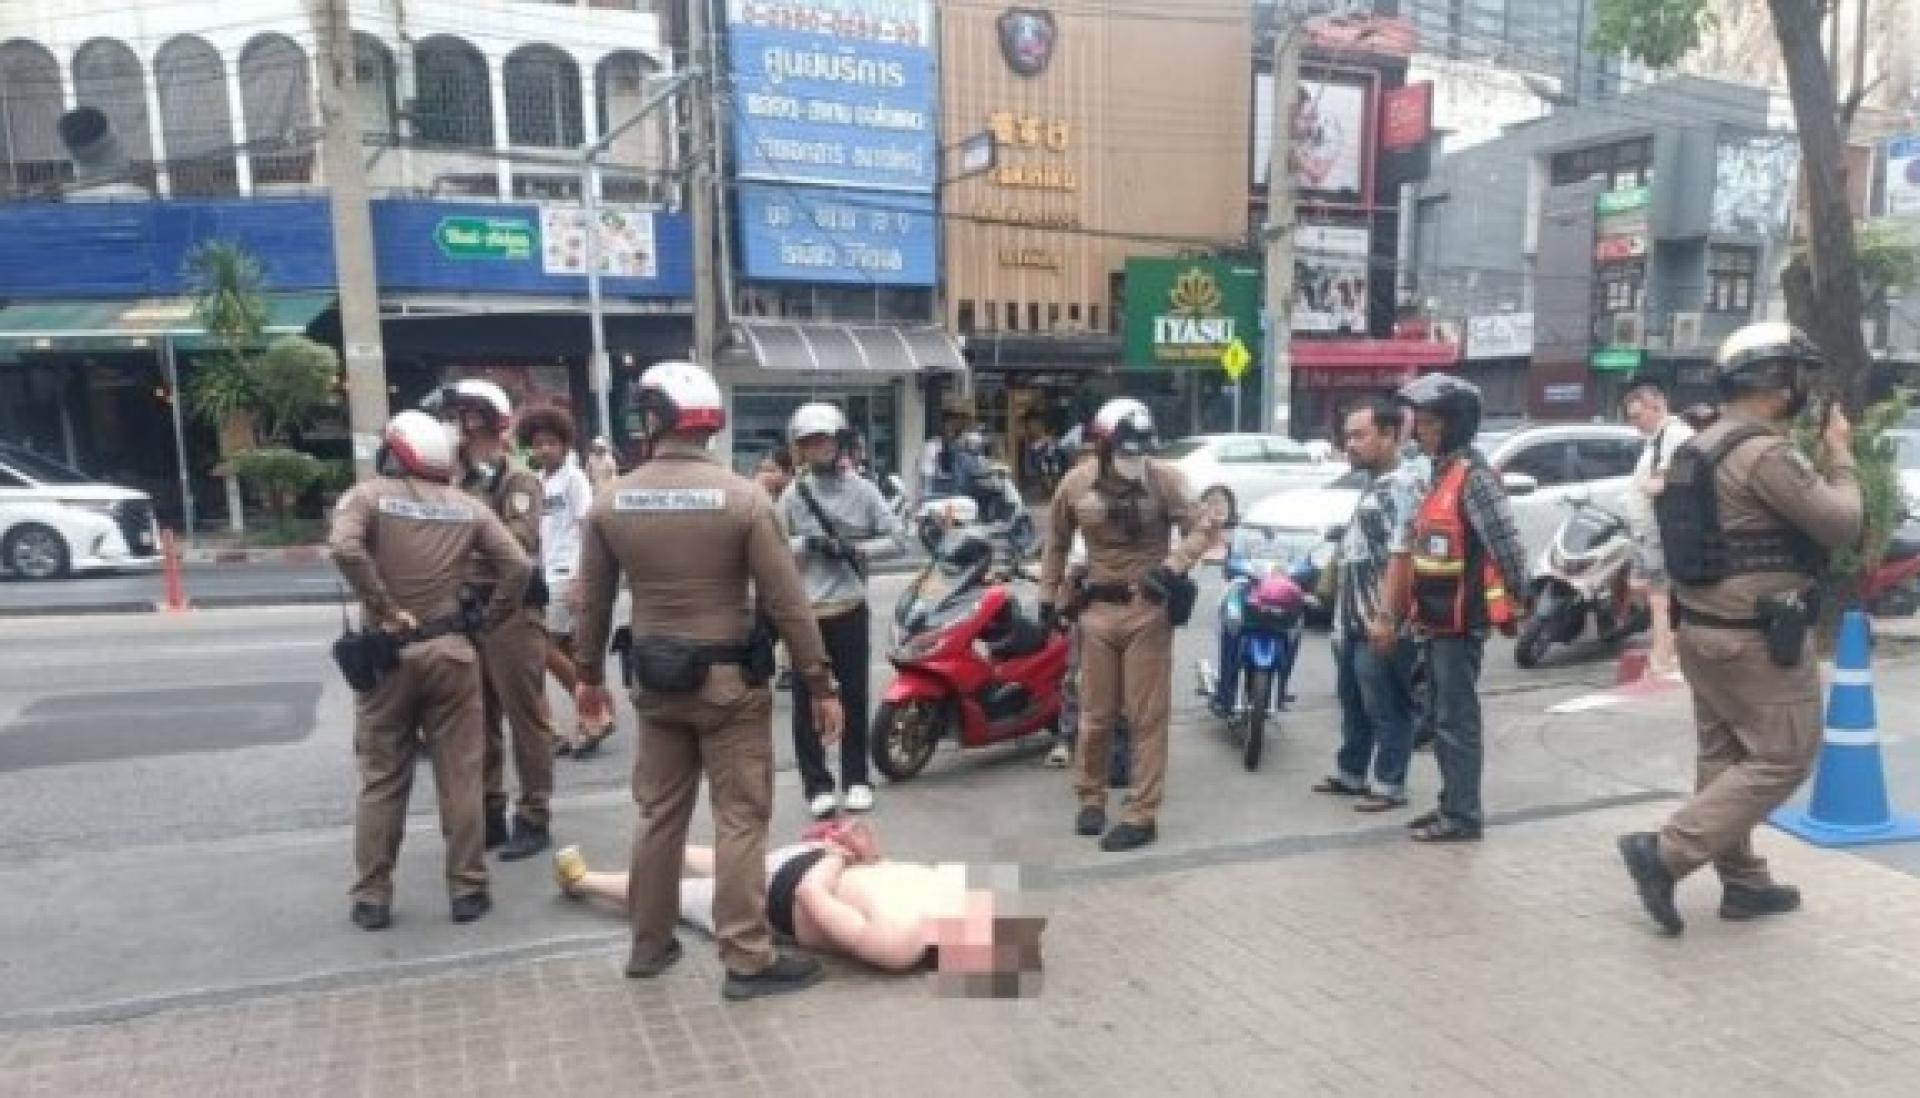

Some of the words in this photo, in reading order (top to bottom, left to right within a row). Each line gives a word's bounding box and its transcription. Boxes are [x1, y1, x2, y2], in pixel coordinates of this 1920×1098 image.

[764, 42, 905, 88] ศูนย์บริการ
[1154, 316, 1237, 344] IYASU
